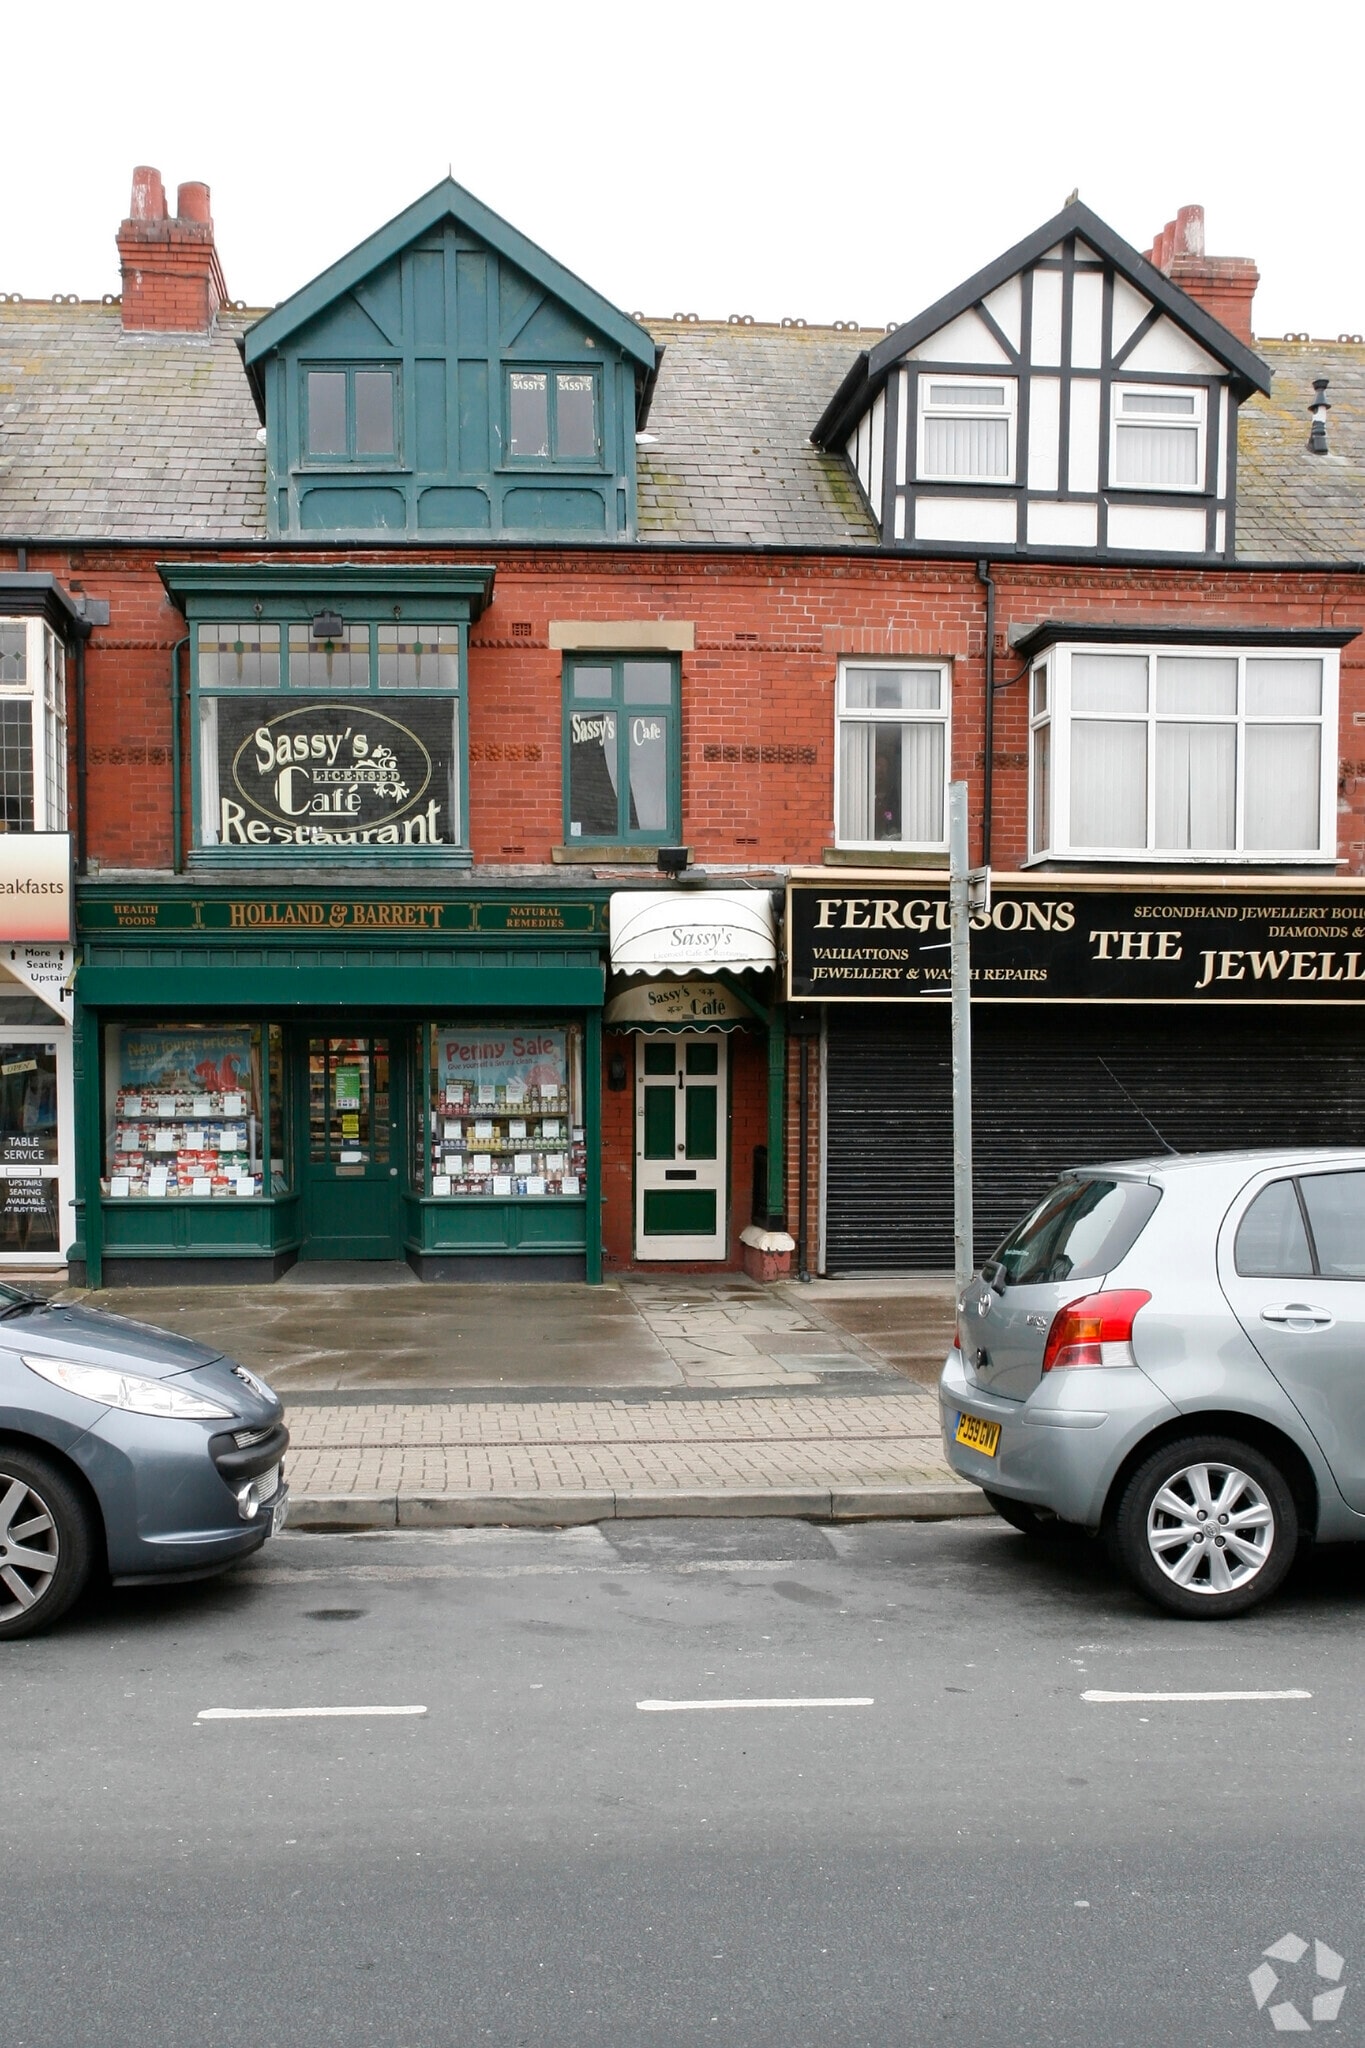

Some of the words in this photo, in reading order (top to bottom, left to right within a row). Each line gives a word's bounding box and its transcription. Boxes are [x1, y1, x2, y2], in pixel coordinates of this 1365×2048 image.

[512, 380, 546, 391] SASSY'S
[558, 381, 592, 392] SASSY'S
[572, 714, 615, 746] Sassy's
[254, 727, 368, 774] Sassy's
[275, 766, 362, 816] Café
[220, 797, 444, 845] Restaurant
[113, 905, 159, 914] HEALTH
[510, 907, 561, 917] NATURAL
[1133, 906, 1238, 918] SECONDHAND
[1238, 907, 1329, 921] JEWELLERY
[1331, 908, 1365, 919] BOU
[118, 916, 157, 926] FOODS
[229, 904, 325, 927] HOLLAND
[329, 905, 348, 928] &
[352, 904, 444, 928] BARRETT
[506, 918, 565, 928] REMEDIES
[1268, 926, 1349, 938] DIAMONDS
[1351, 926, 1365, 938] &
[670, 927, 733, 951] Sassy's
[1088, 931, 1183, 961] THE
[25, 949, 51, 957] More
[812, 948, 909, 960] VALUATIONS
[26, 961, 63, 971] Seating
[31, 973, 70, 983] Upstair
[810, 966, 904, 982] JEWELLERY
[905, 968, 920, 980] &
[984, 969, 1048, 981] REPAIRS
[647, 985, 690, 1006] Sassy's
[202, 1034, 244, 1049] prices
[445, 1041, 506, 1062] Penny
[512, 1035, 554, 1057] Sale
[8, 1136, 40, 1147] TABLE
[4, 1149, 45, 1160] SERVICE
[8, 1179, 43, 1187] UPSTAIRS
[9, 1188, 42, 1196] SEATING
[5, 1197, 46, 1205] AVAILABLE
